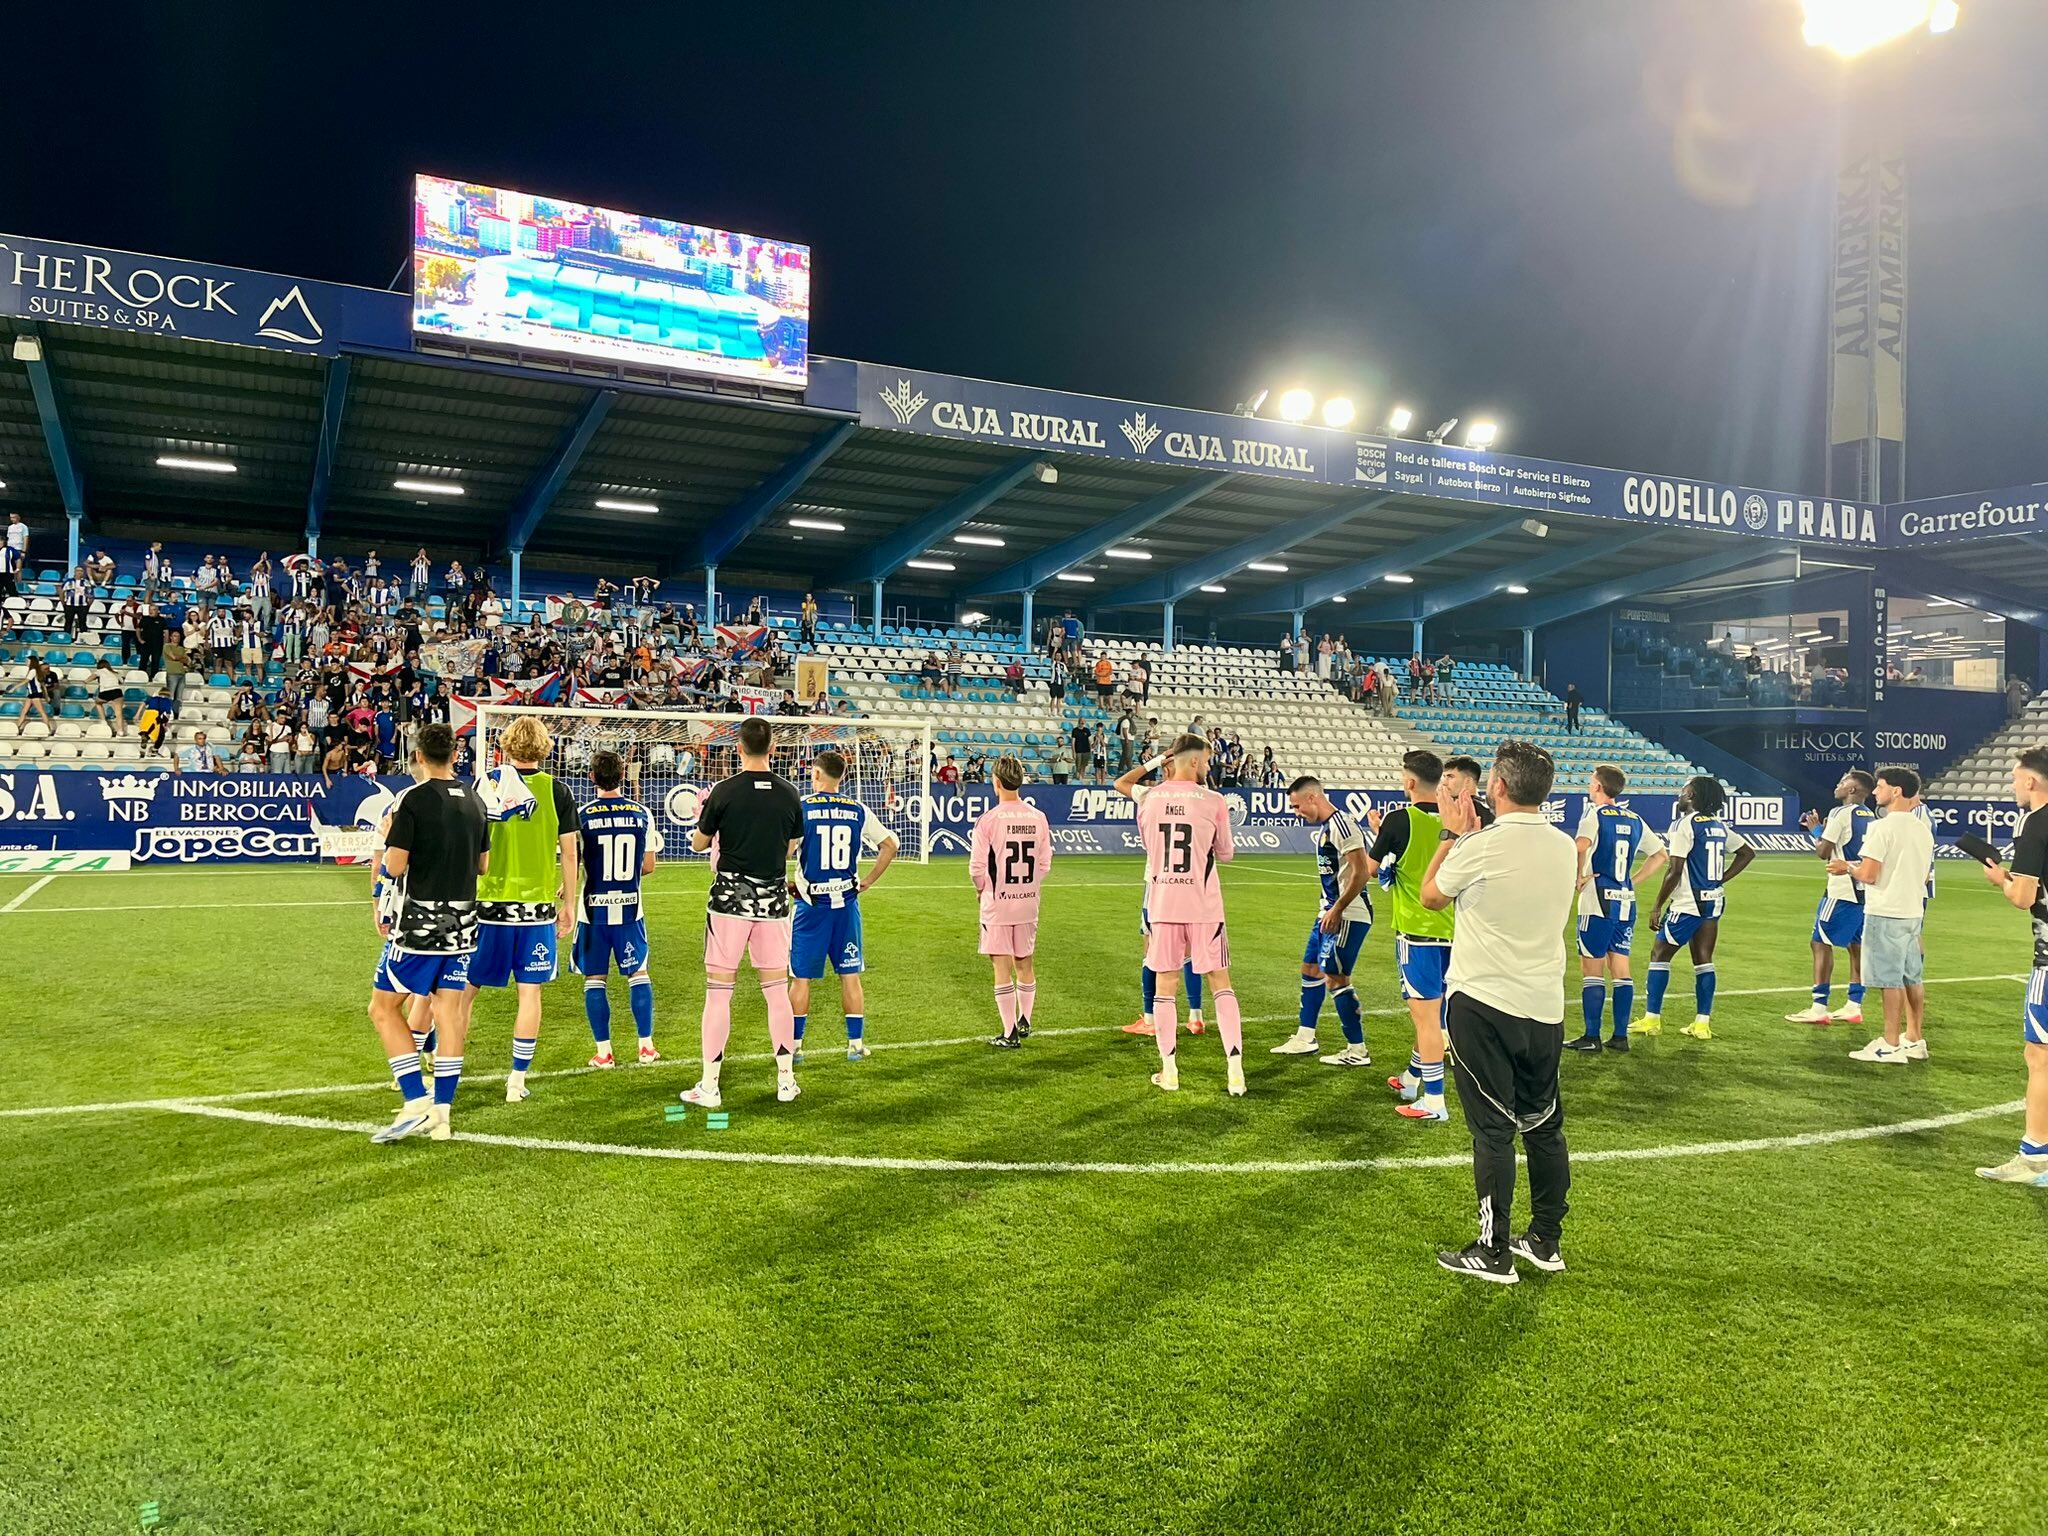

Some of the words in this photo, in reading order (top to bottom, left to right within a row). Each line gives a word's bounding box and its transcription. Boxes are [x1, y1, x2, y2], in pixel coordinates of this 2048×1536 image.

[0, 243, 237, 316] HEROCK
[29, 296, 109, 321] SUITES
[114, 312, 129, 325] &
[136, 308, 177, 331] SPA
[932, 402, 1004, 436] CAJA
[1010, 413, 1106, 448] RURAL
[1164, 432, 1226, 461] CAJA
[1231, 440, 1315, 473] RURAL
[1357, 448, 1386, 459] BOSCH
[1357, 457, 1386, 468] Service
[1395, 452, 1414, 464] Red
[1417, 454, 1429, 466] de
[1431, 457, 1467, 471] talleres
[1469, 462, 1497, 475] Bosch
[1499, 466, 1515, 478] Car
[1517, 469, 1550, 483] Service
[1552, 473, 1561, 484] El
[1563, 475, 1591, 488] Bierzo
[1395, 470, 1423, 484] Saygal
[1438, 476, 1473, 489] Autobox
[1474, 481, 1501, 493] Bierzo
[1513, 485, 1557, 500] Autobierzo
[1558, 491, 1591, 504] Sigfredo
[1623, 477, 1737, 526] GODELLO
[1777, 500, 1877, 543] PRADA
[1899, 501, 2040, 536] Carrefour
[1874, 655, 1886, 701] TOUR
[1805, 753, 1836, 762] SUITES
[1847, 753, 1864, 762] SPA
[173, 780, 326, 798] INMOBILIARIA
[1088, 789, 1134, 820] PEÑA
[108, 801, 149, 821] NB
[181, 803, 311, 822] BERROCAL
[586, 804, 609, 814] CAJA
[1165, 802, 1186, 815] ÁNGEL
[1739, 802, 1778, 820] one
[132, 829, 320, 862] JopeCar
[155, 829, 240, 837] ELEVACIONES
[1012, 825, 1036, 834] BARREDO
[1051, 829, 1099, 844] HOTEL
[24, 843, 39, 851] de
[598, 834, 636, 881] 10
[817, 825, 852, 870] 18
[1006, 841, 1035, 884] 25
[1158, 823, 1193, 873] 13
[1615, 840, 1629, 881] 8
[1705, 841, 1724, 880] 16
[599, 896, 636, 905] VALCARCE
[1008, 892, 1036, 900] VALCARCE
